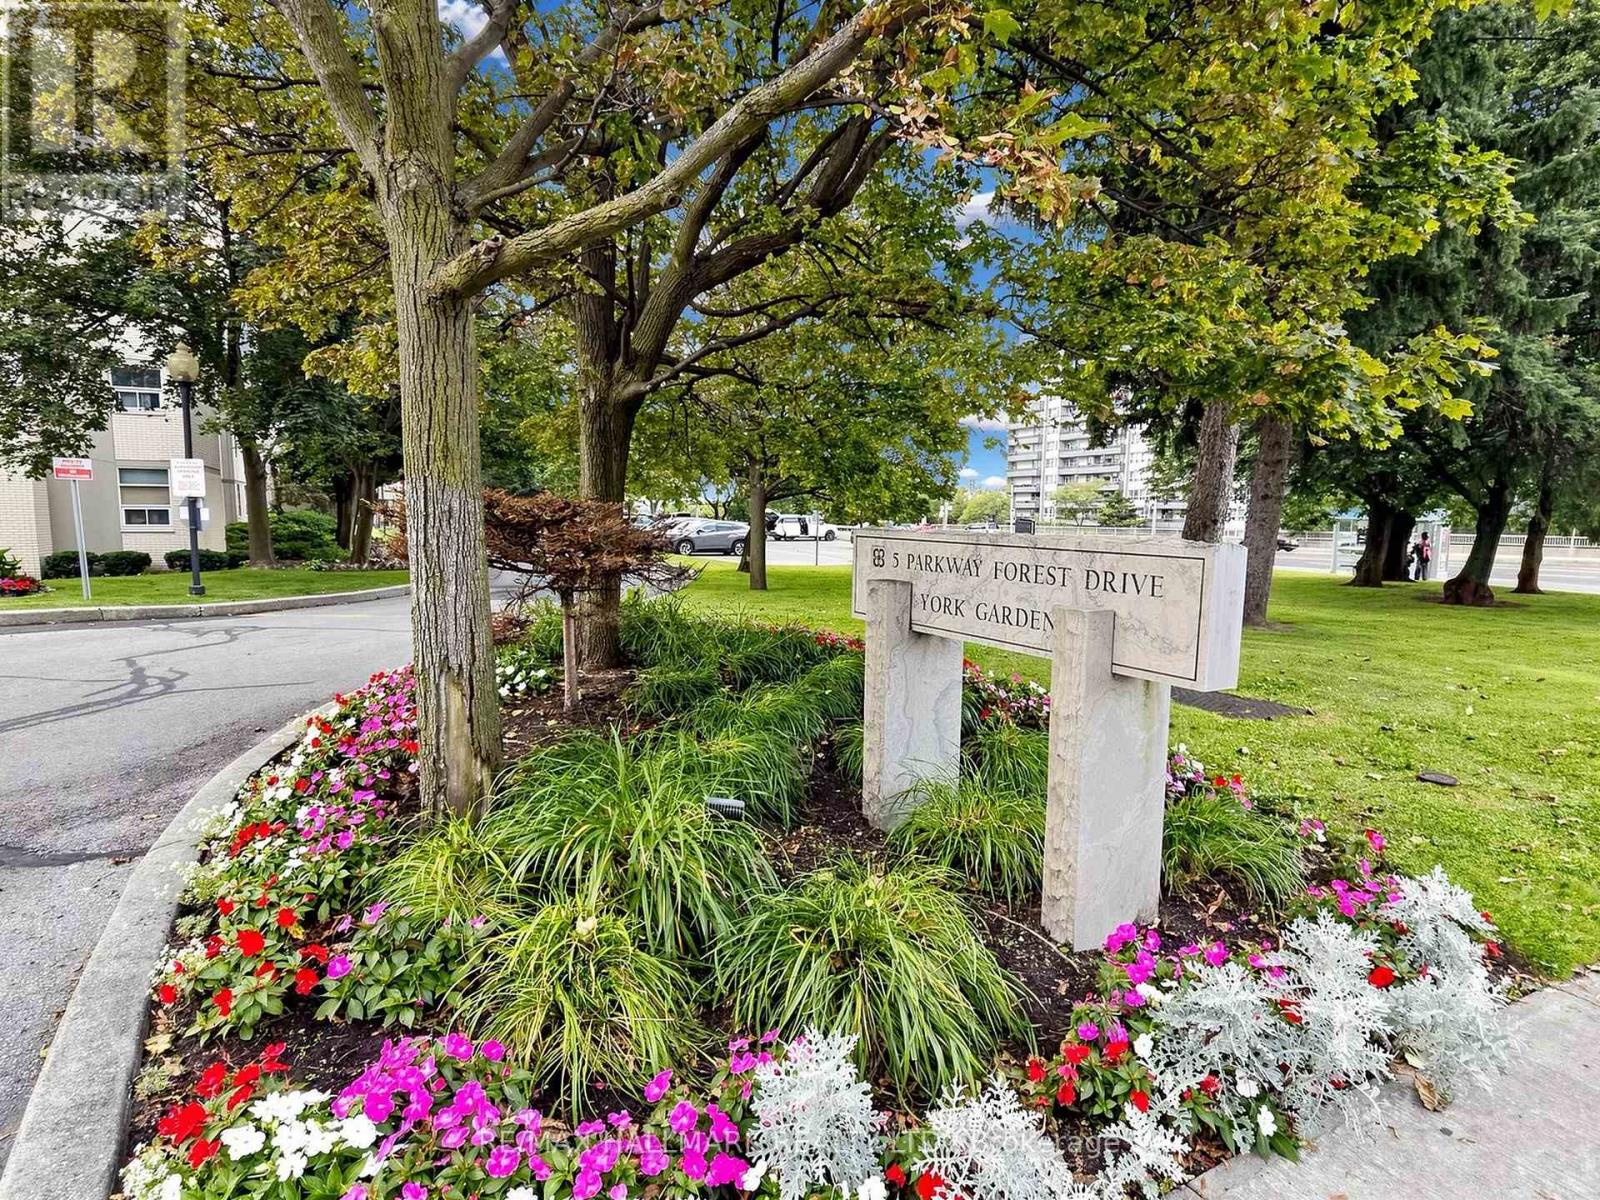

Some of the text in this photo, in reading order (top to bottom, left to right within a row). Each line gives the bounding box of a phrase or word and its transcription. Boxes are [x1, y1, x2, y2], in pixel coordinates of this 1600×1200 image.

[892, 552, 1165, 599] 5 PARKWAY FOREST DRIVE
[920, 593, 967, 618] YORK
